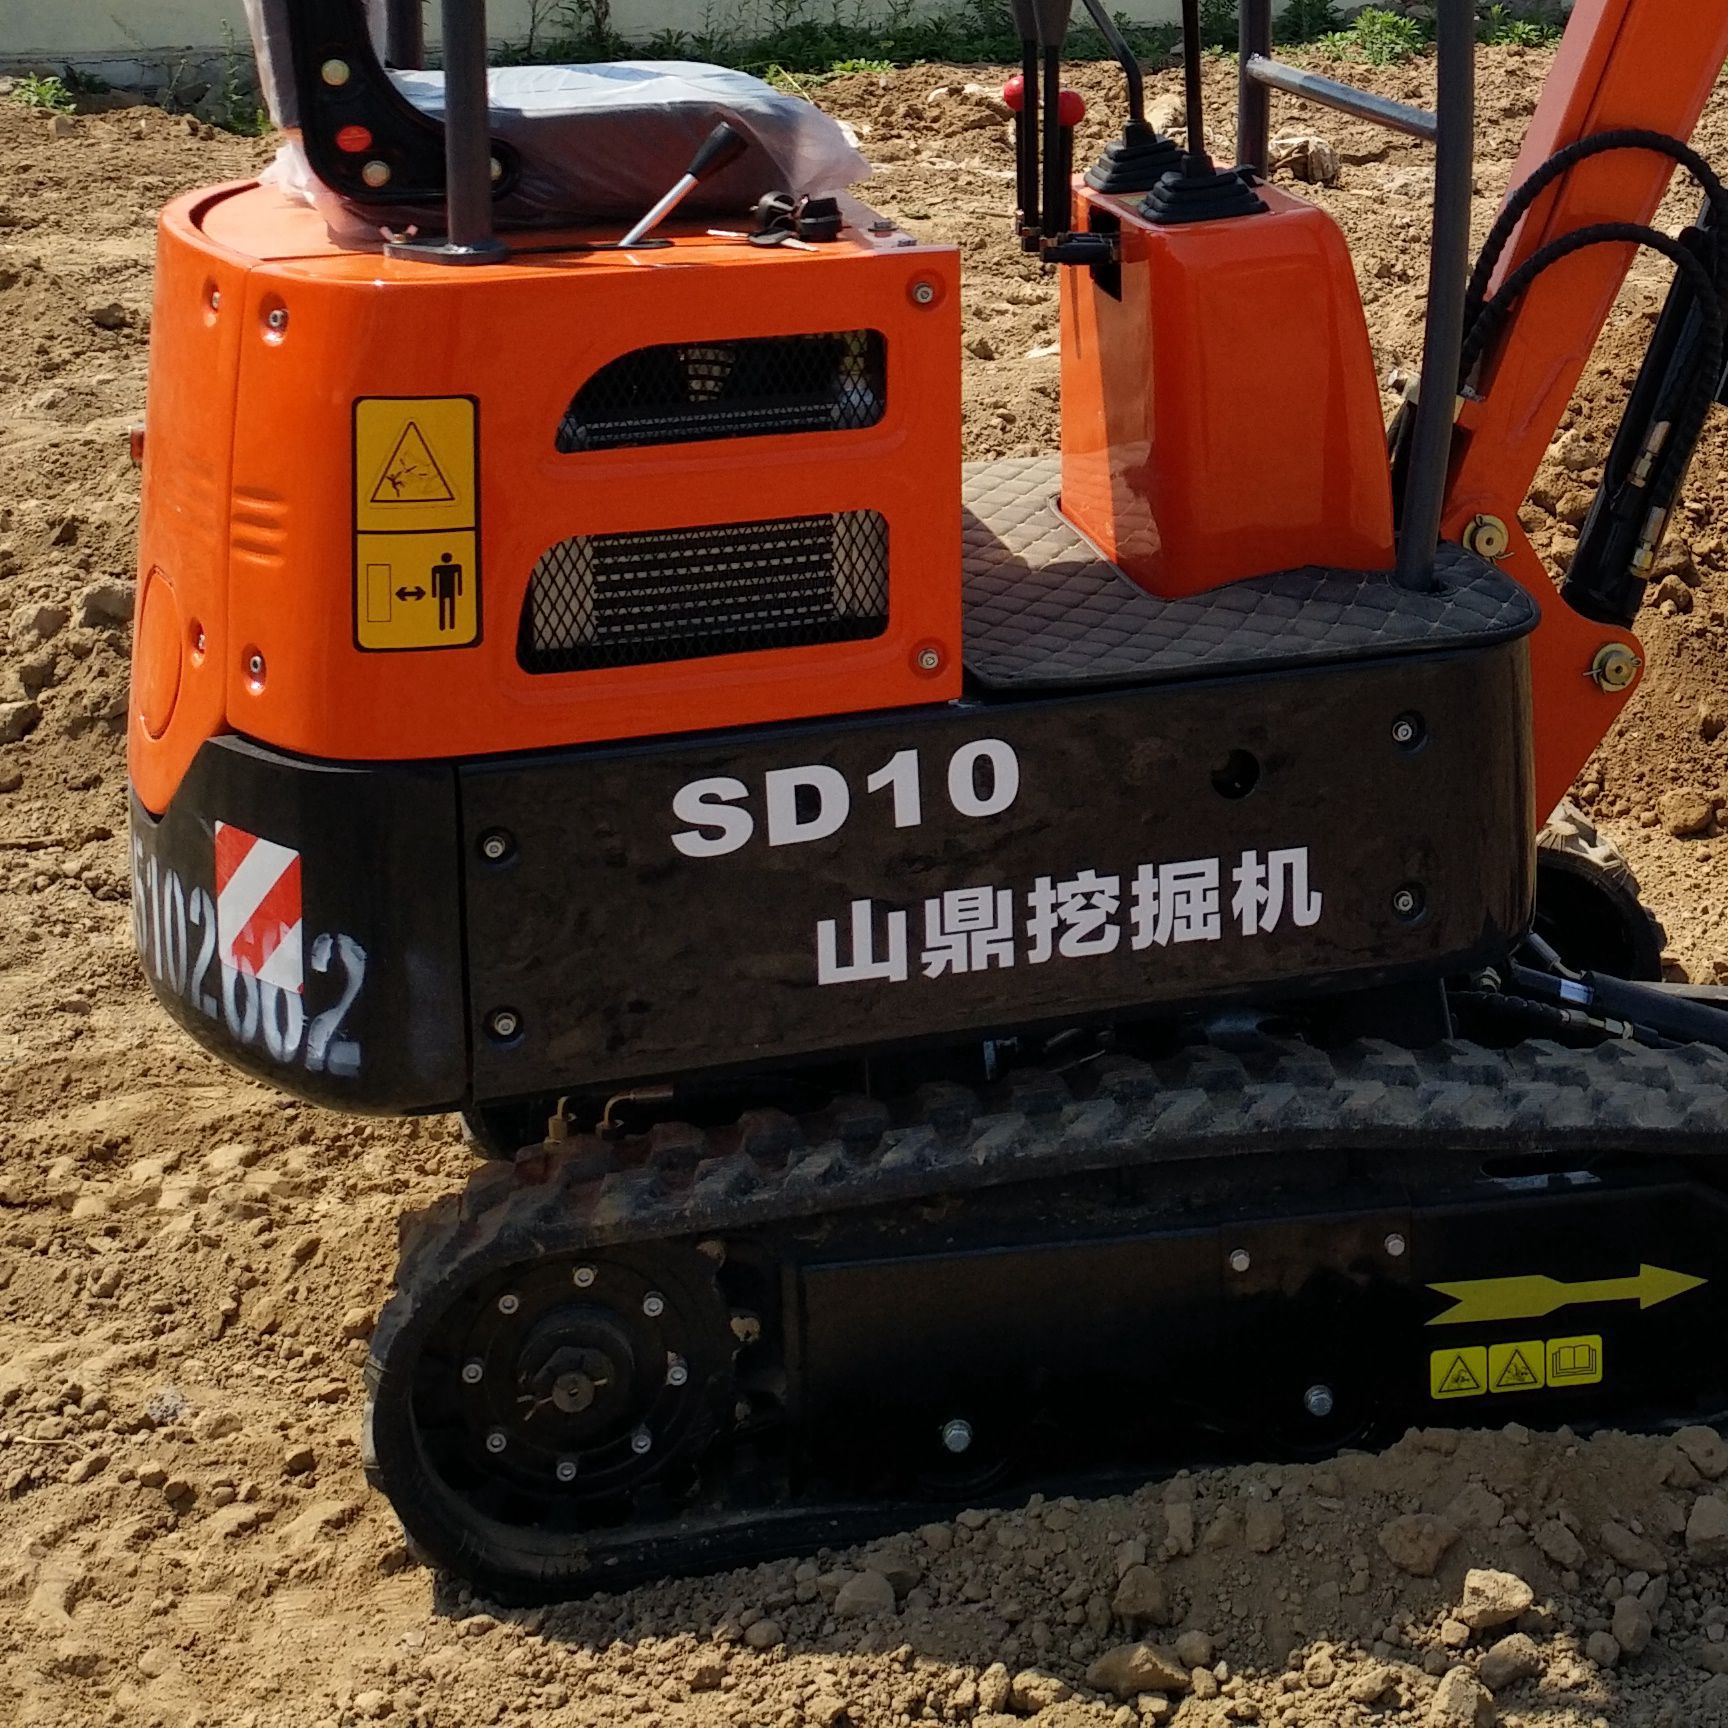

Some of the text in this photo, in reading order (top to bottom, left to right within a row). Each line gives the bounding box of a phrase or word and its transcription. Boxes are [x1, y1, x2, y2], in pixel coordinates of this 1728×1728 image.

[670, 738, 1020, 858] SD10
[815, 846, 1323, 986] 山鼎挖掘机
